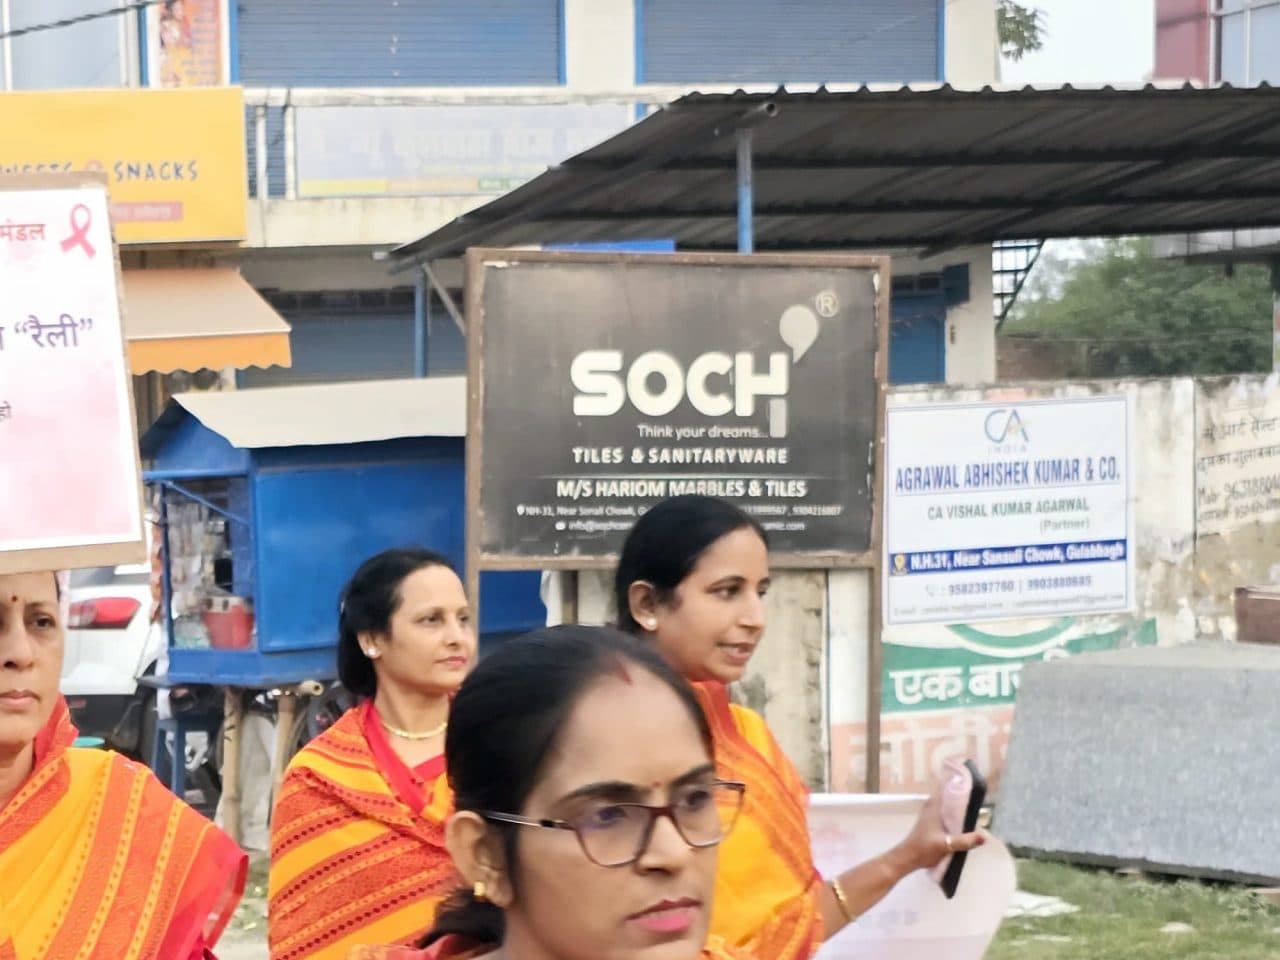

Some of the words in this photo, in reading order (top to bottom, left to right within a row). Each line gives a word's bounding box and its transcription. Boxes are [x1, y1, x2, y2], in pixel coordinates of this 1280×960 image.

[113, 160, 199, 182] SNACKS
[570, 350, 790, 418] SOCH
[637, 424, 672, 438] Think
[675, 426, 706, 441] your
[572, 447, 623, 464] TILES
[631, 447, 645, 464] &
[648, 447, 788, 464] SANITARYWARE
[895, 464, 960, 493] AGRAWAL
[964, 460, 1029, 488] ABHISHEK
[1034, 457, 1080, 484] KUMAR
[1085, 456, 1094, 481] &
[1099, 456, 1120, 481] CO.
[556, 480, 593, 500] M/S
[595, 480, 665, 498] HARIOM
[669, 480, 745, 498] MARBLES
[748, 480, 762, 497] &
[765, 480, 808, 498] TILES
[927, 506, 943, 522] CA
[947, 503, 988, 520] VISHAL
[991, 501, 1033, 517] KUMAR
[1035, 497, 1090, 514] AGARWAL
[889, 666, 963, 705] एक
